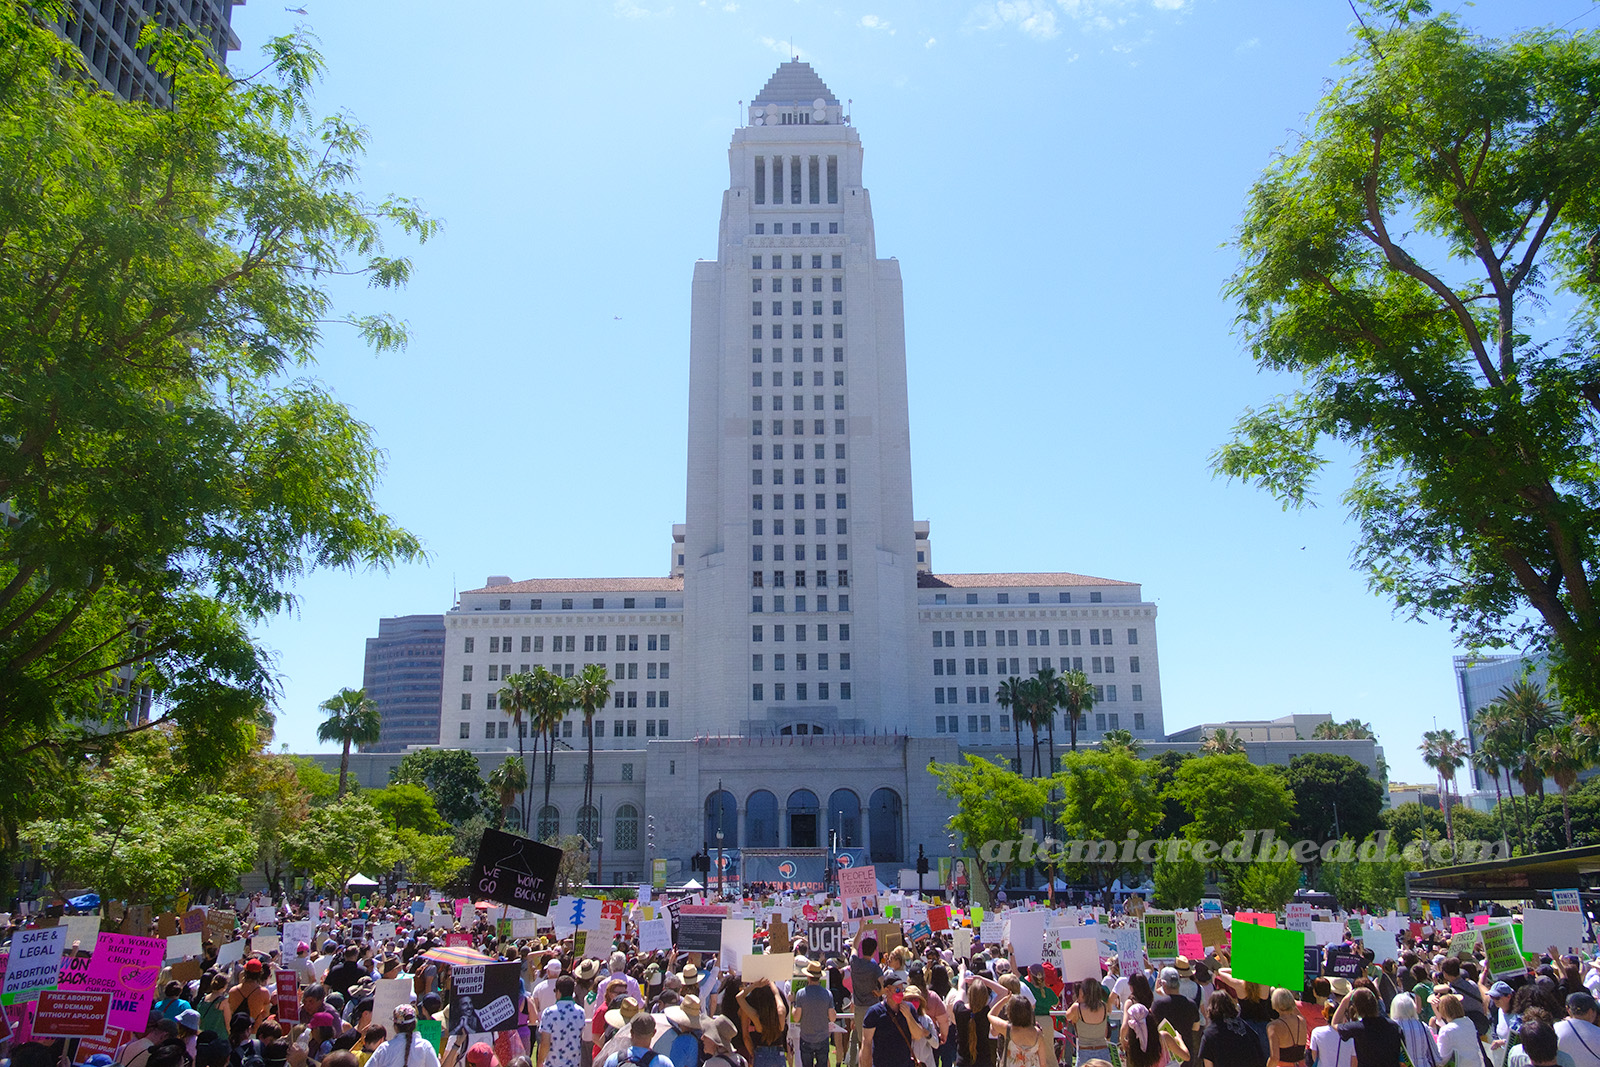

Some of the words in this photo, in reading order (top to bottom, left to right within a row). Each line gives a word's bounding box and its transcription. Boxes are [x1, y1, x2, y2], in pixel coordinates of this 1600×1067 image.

[483, 865, 501, 879] WE
[517, 874, 544, 889] WONT
[842, 869, 874, 881] PEOPLE
[479, 878, 497, 894] GO
[514, 887, 545, 903] BACK!!
[792, 881, 824, 890] MARCH
[1145, 916, 1176, 924] OVERTURN
[22, 932, 50, 944] SAFE
[51, 930, 58, 940] &
[1148, 926, 1164, 938] ROE
[1166, 926, 1172, 938] ?
[1456, 932, 1475, 942] FORCED
[1485, 928, 1508, 940] ABORTION
[99, 935, 114, 944] IT'S
[128, 938, 166, 949] WOMAN'S
[809, 926, 842, 952] UGH
[1147, 940, 1161, 950] HELL
[1164, 940, 1176, 950] NO!
[20, 945, 56, 959] LEGAL
[108, 945, 134, 954] RIGHT
[140, 948, 151, 956] TO
[1124, 950, 1136, 960] ARE
[1334, 964, 1358, 973] BODY
[1494, 958, 1518, 970] APOLOGY
[8, 964, 58, 981] ABORTION
[121, 967, 142, 983] FUCK
[453, 966, 474, 976] What
[474, 966, 484, 974] do
[6, 982, 20, 992] ON
[20, 976, 56, 990] DEMAND
[58, 972, 88, 984] BACK
[88, 978, 116, 988] FORCED
[455, 976, 483, 985] women
[86, 986, 126, 998] CHILDBRTH
[130, 992, 138, 1000] IS
[458, 984, 482, 994] want?
[112, 1000, 138, 1012] IME
[478, 1007, 488, 1017] ALL
[489, 996, 510, 1012] RIGHTS
[480, 1014, 492, 1024] ALL
[492, 1002, 512, 1018] RIGHTS
[484, 1019, 494, 1030] ALL
[494, 1009, 514, 1024] RIGHTS
